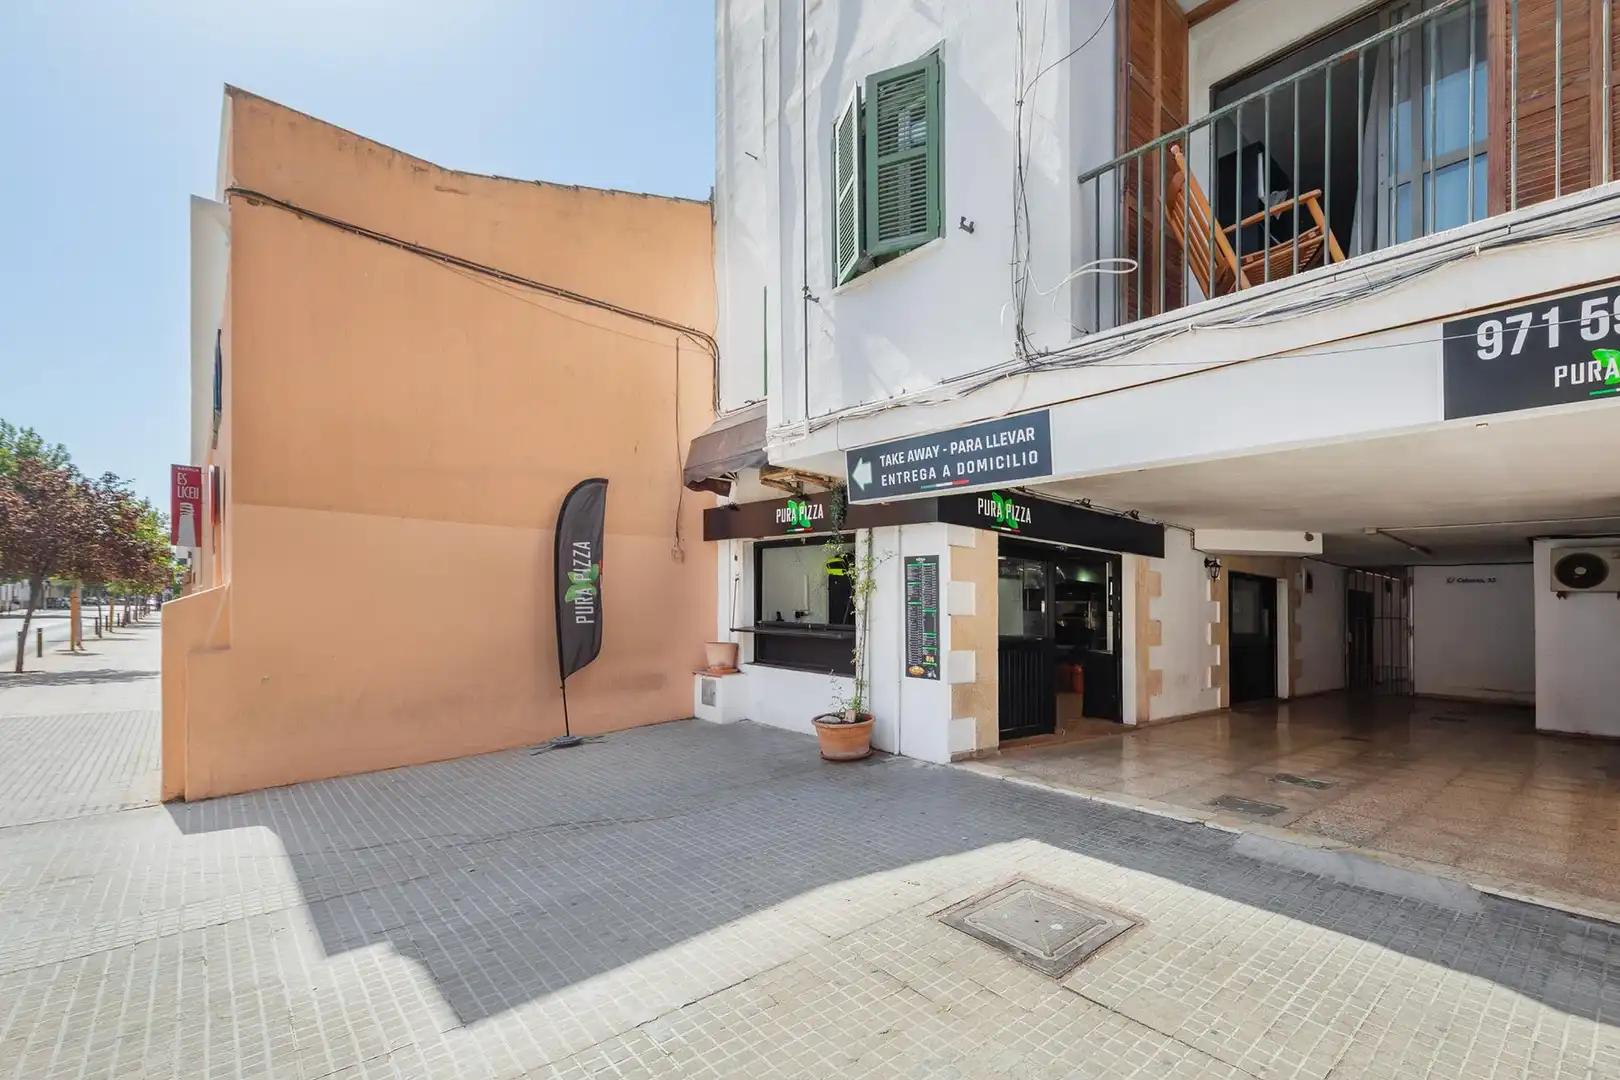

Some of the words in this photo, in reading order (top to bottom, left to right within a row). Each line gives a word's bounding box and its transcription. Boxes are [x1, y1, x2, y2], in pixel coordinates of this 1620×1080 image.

[1476, 306, 1560, 360] 971
[1554, 356, 1620, 388] PURA
[879, 452, 905, 468] TAKE
[907, 445, 940, 463] AWAY
[950, 437, 983, 455] PARA
[986, 426, 1035, 449] LLEVAR
[177, 472, 188, 485] ES
[881, 466, 937, 487] ENTREGA
[942, 465, 951, 477] A
[957, 450, 1039, 476] DOMICILIO
[776, 506, 797, 523] PURA
[799, 503, 824, 521] PIZZA
[977, 497, 1003, 518] PURA
[1005, 503, 1032, 524] PIZZA
[572, 541, 592, 581] PIZZA
[574, 587, 595, 624] PURA
